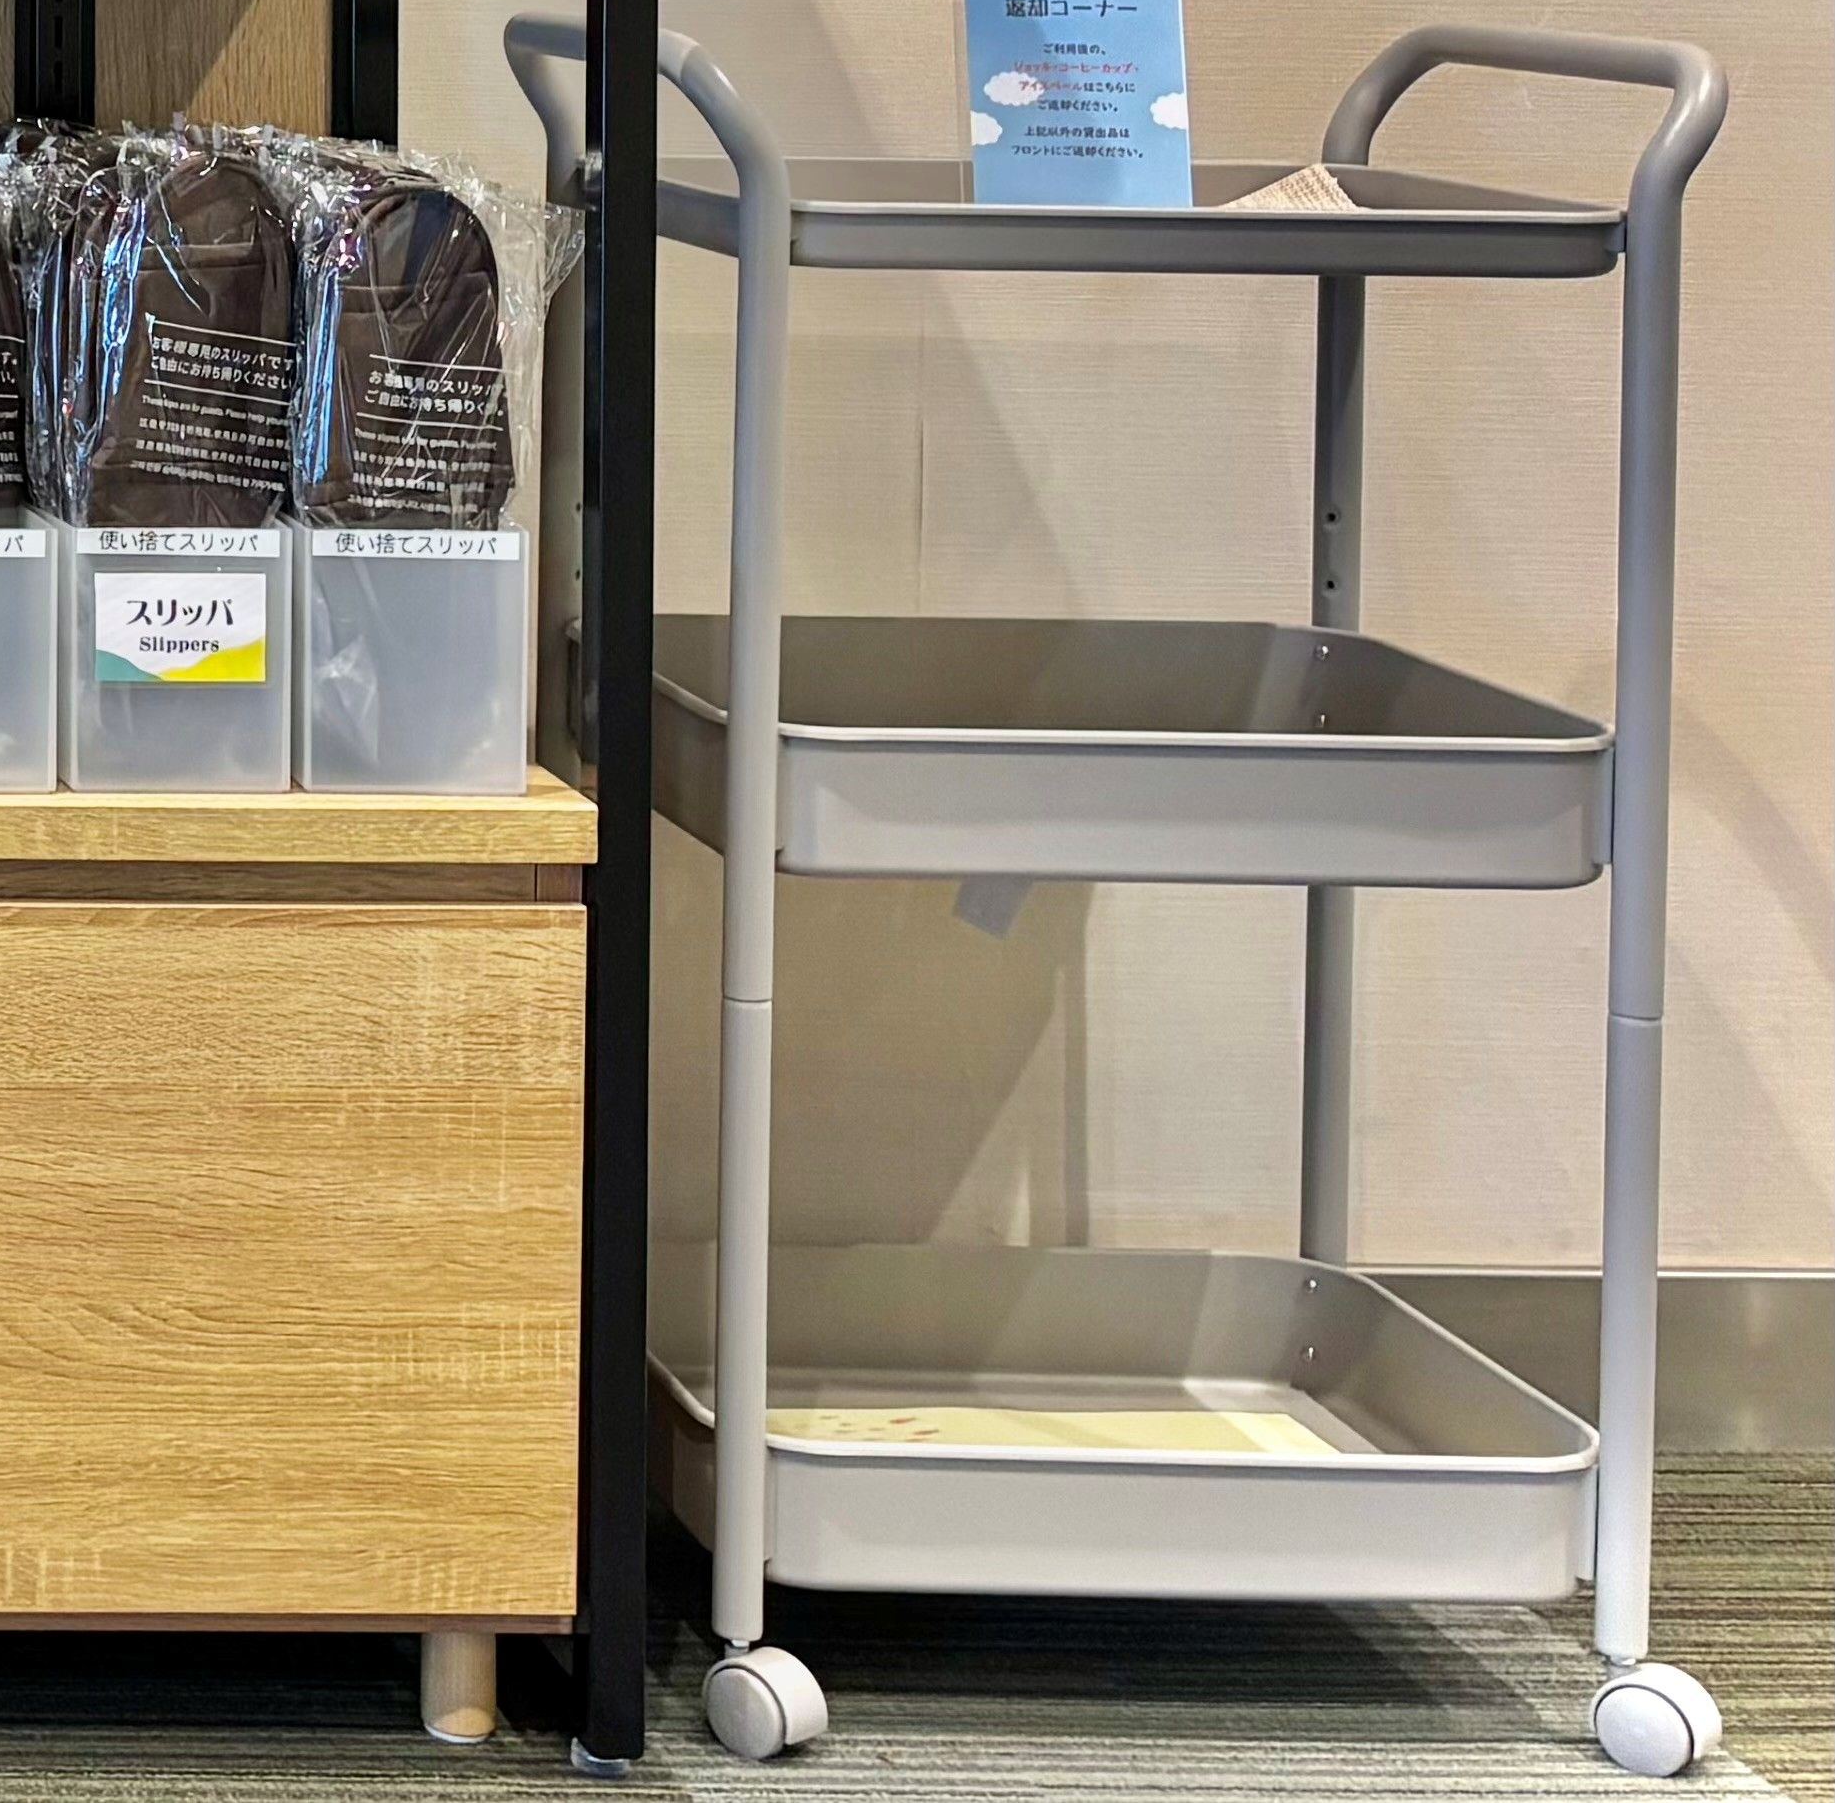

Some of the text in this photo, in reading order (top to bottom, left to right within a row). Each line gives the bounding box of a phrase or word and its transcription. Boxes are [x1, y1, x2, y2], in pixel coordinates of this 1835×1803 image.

[99, 529, 260, 553] 使い捨てスリッパ
[334, 532, 497, 556] 使い捨てスリッパ
[126, 598, 234, 626] スリッパ
[139, 636, 220, 653] Slippers
